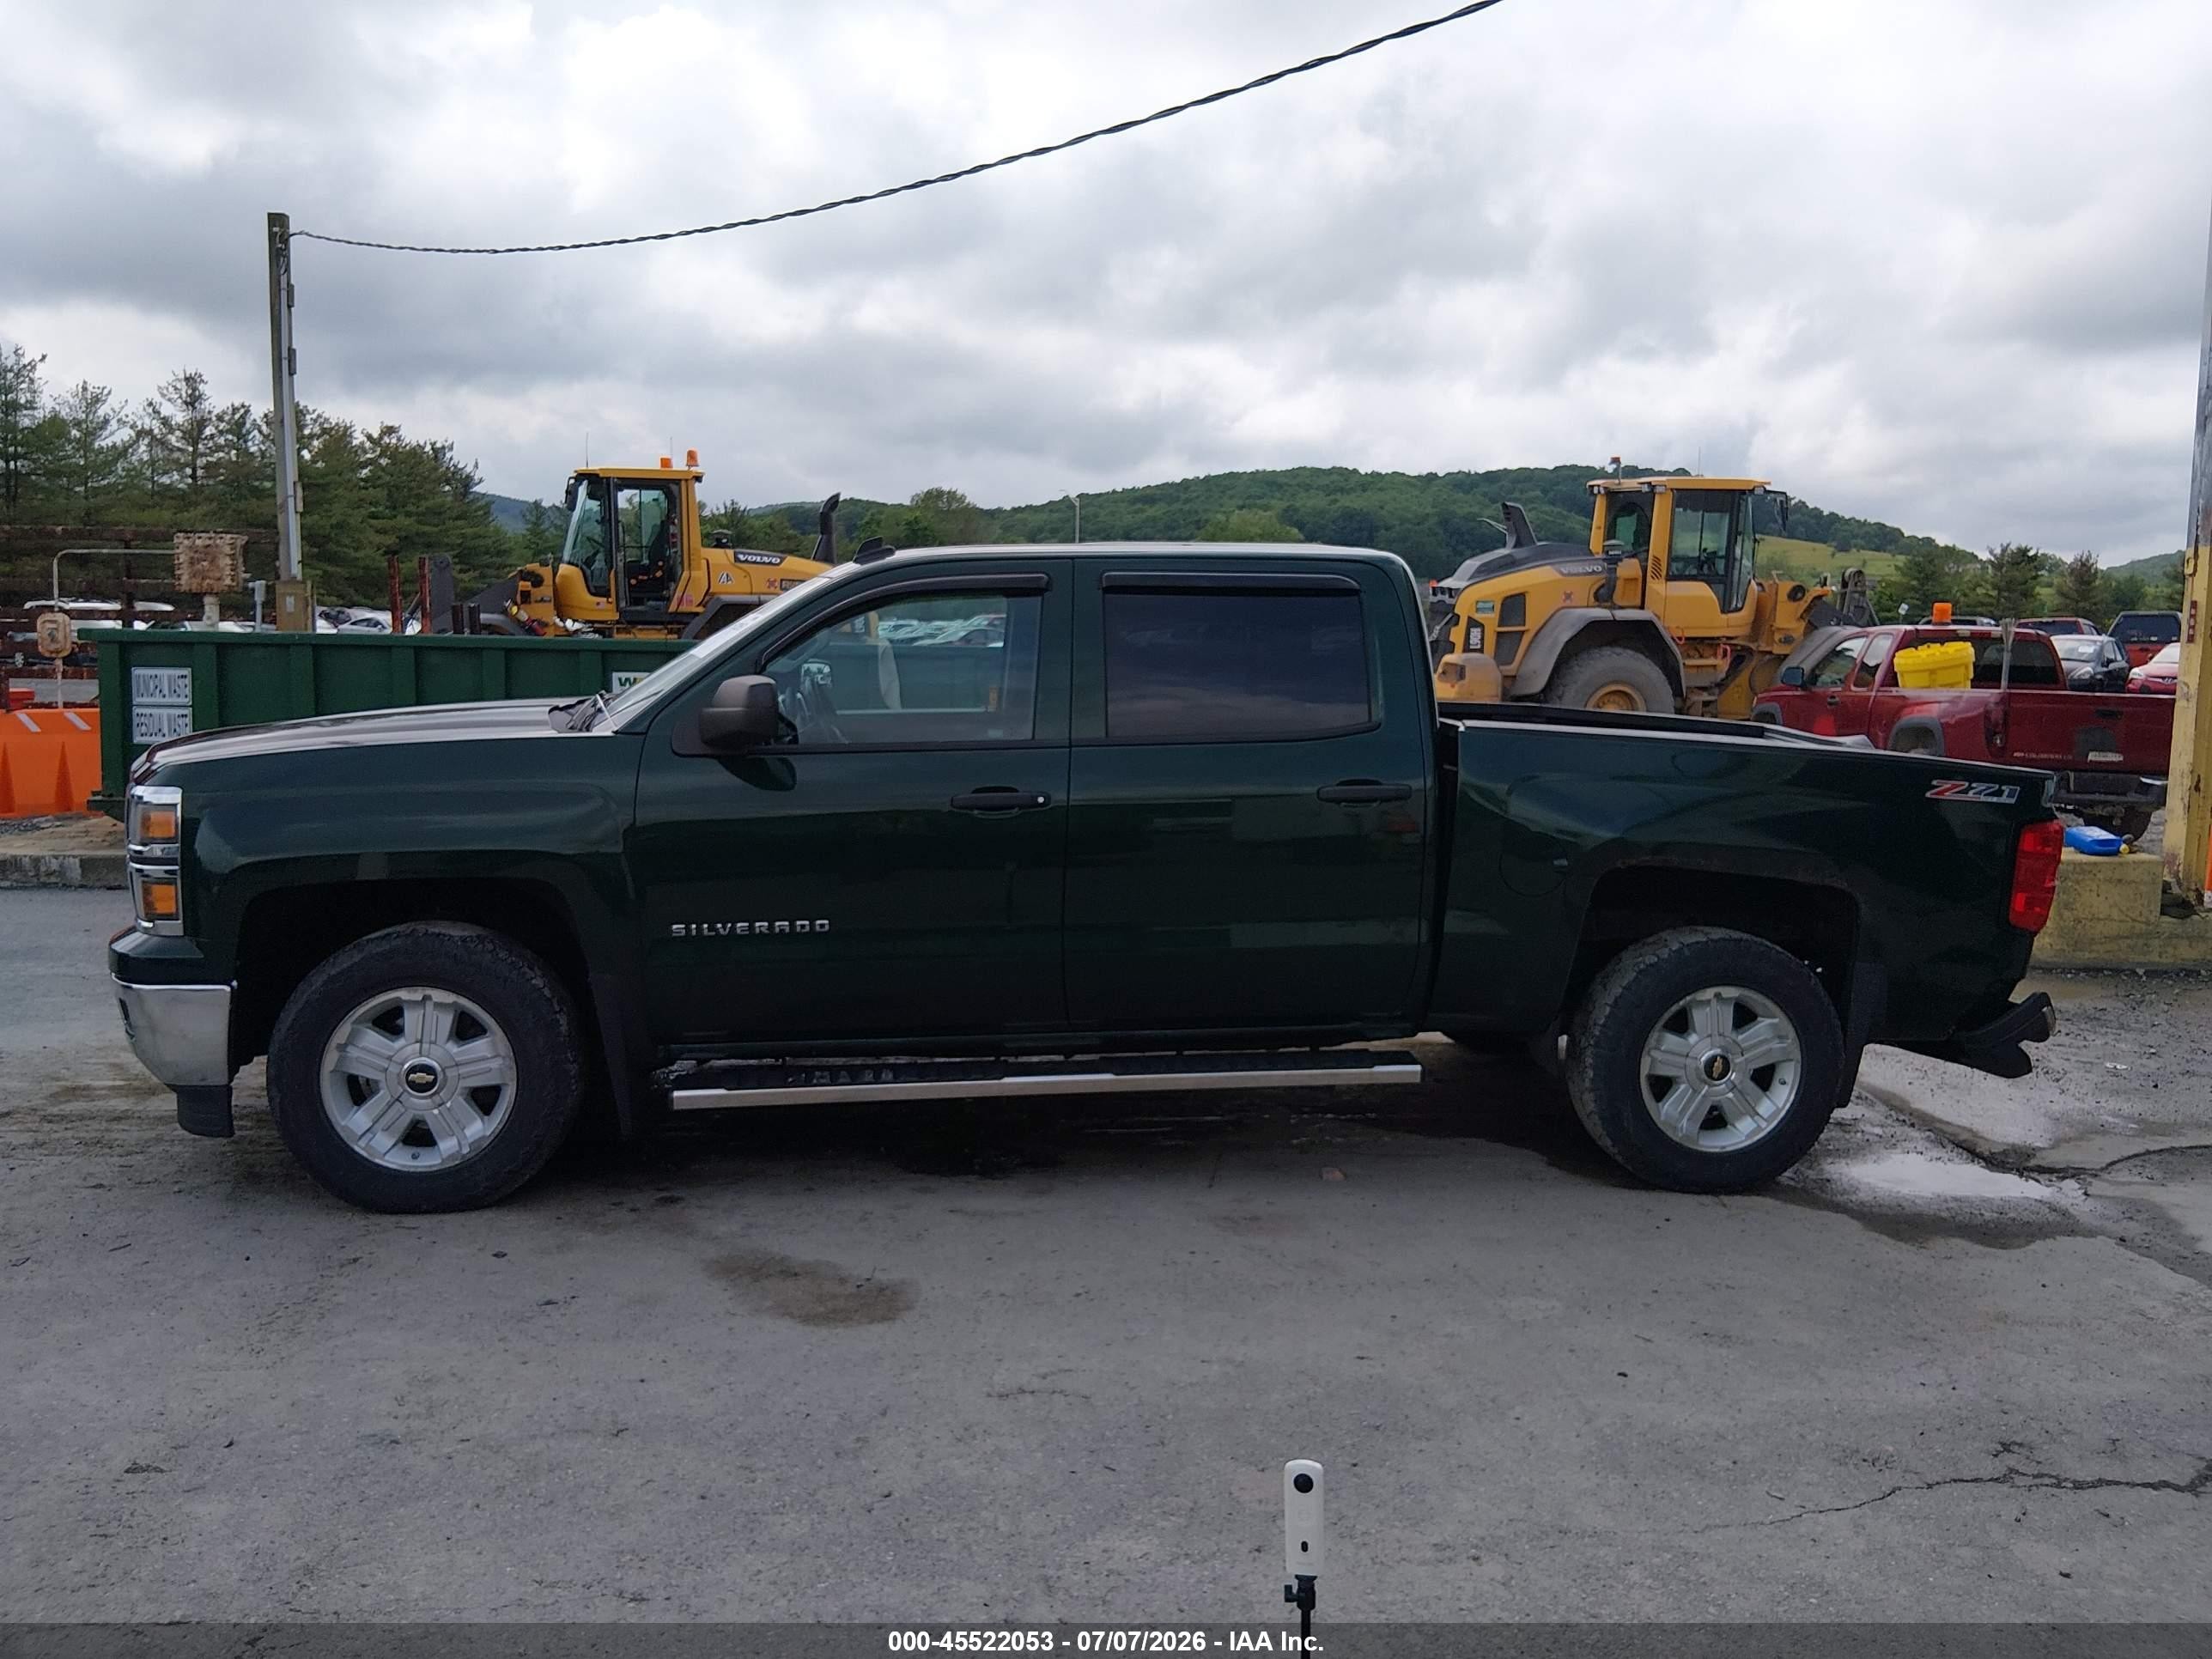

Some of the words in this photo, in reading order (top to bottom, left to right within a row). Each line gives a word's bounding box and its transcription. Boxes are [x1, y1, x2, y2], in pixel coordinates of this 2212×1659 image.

[738, 553, 781, 564] VOLVO
[1924, 779, 2021, 805] Z71
[671, 920, 830, 937] SILVERADO
